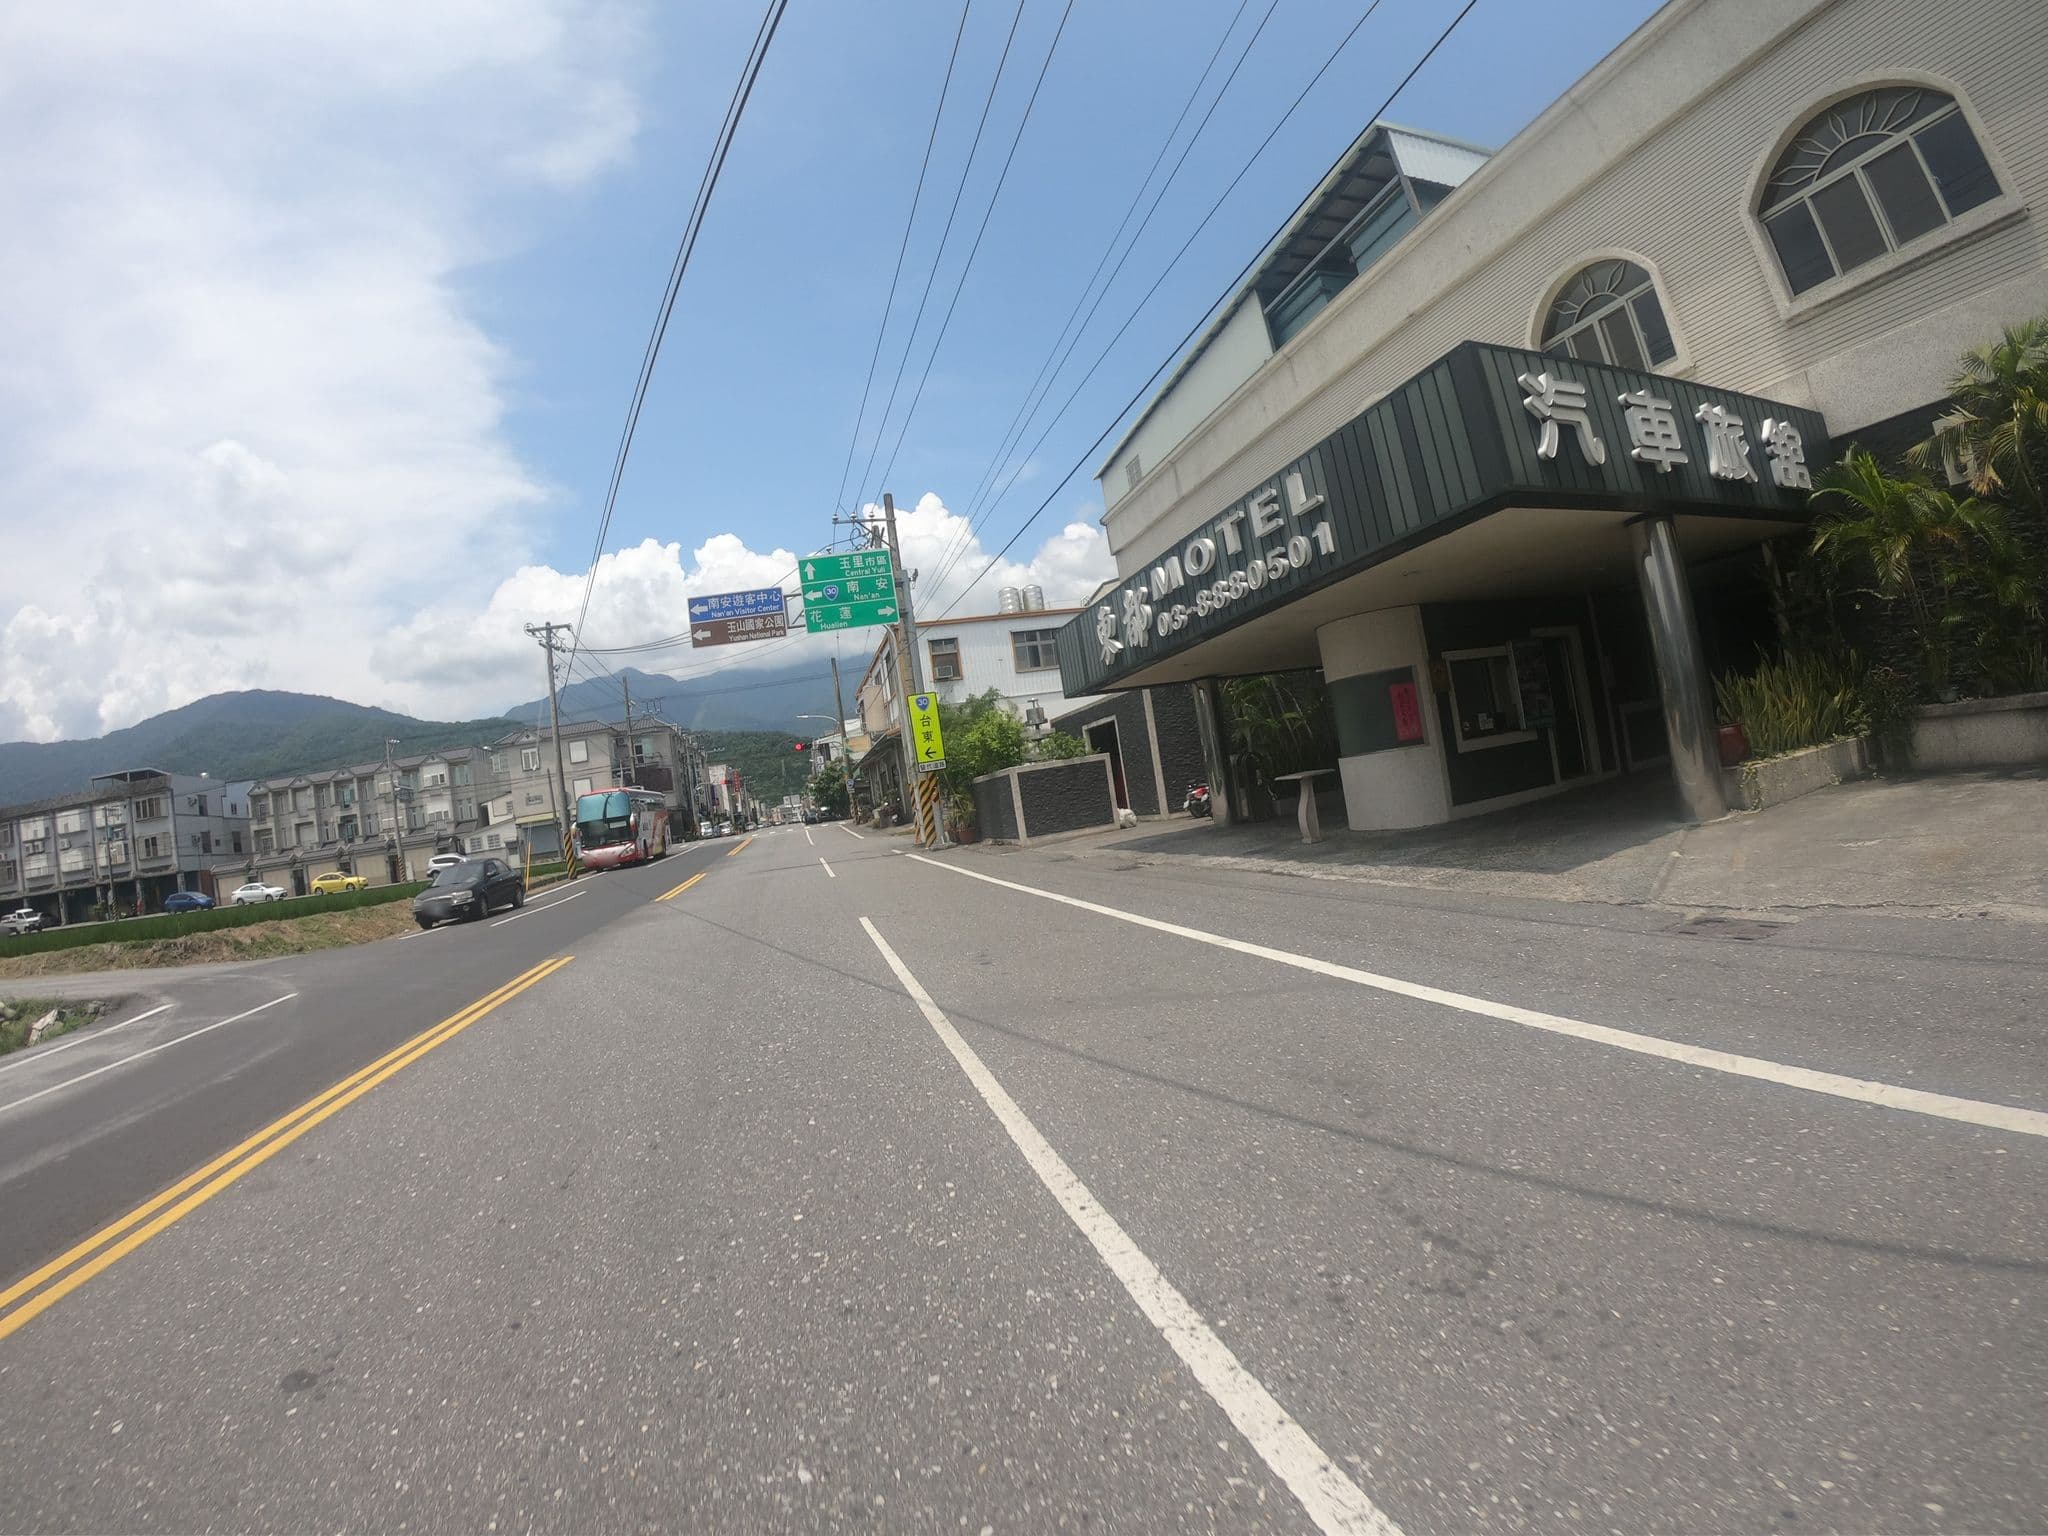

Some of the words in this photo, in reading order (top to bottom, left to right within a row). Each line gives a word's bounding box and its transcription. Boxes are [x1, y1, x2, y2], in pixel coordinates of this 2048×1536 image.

[1518, 372, 1814, 490] 汽車旅館
[1150, 472, 1324, 601] MOTEL
[839, 556, 887, 571] 玉里市區
[845, 568, 870, 577] Central
[871, 565, 886, 574] Yuli
[847, 578, 889, 593] 南安
[1157, 522, 1335, 637] 03-8880501
[827, 587, 836, 595] 30
[854, 592, 880, 601] Nan'an
[708, 589, 782, 610] 南安遊客中心
[711, 609, 734, 618] Nan'an
[735, 606, 756, 616] Visitor
[757, 603, 780, 613] Center
[810, 606, 853, 623] 花蓮
[727, 616, 785, 634] 玉山國家公園
[820, 620, 848, 629] Hualien
[920, 714, 935, 743] 台東
